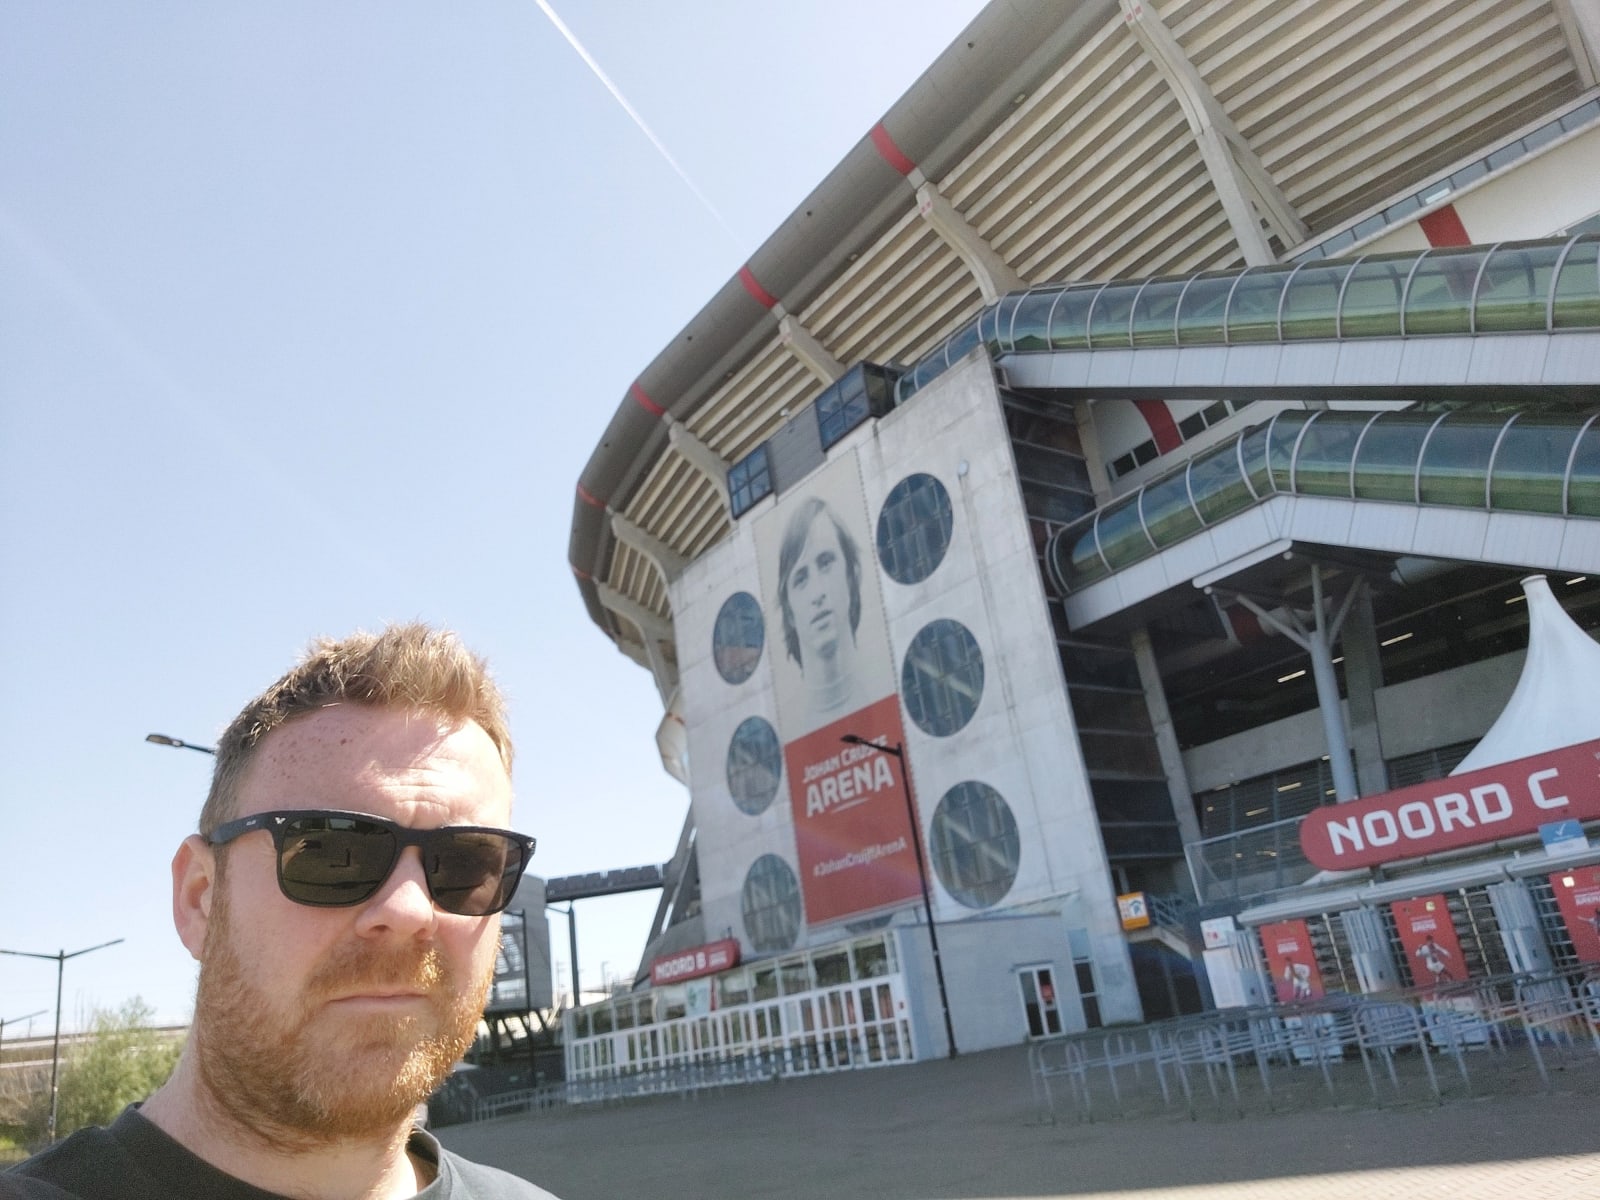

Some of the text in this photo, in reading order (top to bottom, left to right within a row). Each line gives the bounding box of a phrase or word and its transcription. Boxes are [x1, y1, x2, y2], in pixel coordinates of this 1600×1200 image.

[806, 755, 895, 818] ARENA
[1326, 767, 1569, 856] NOORD C
[655, 954, 695, 981] NOORD
